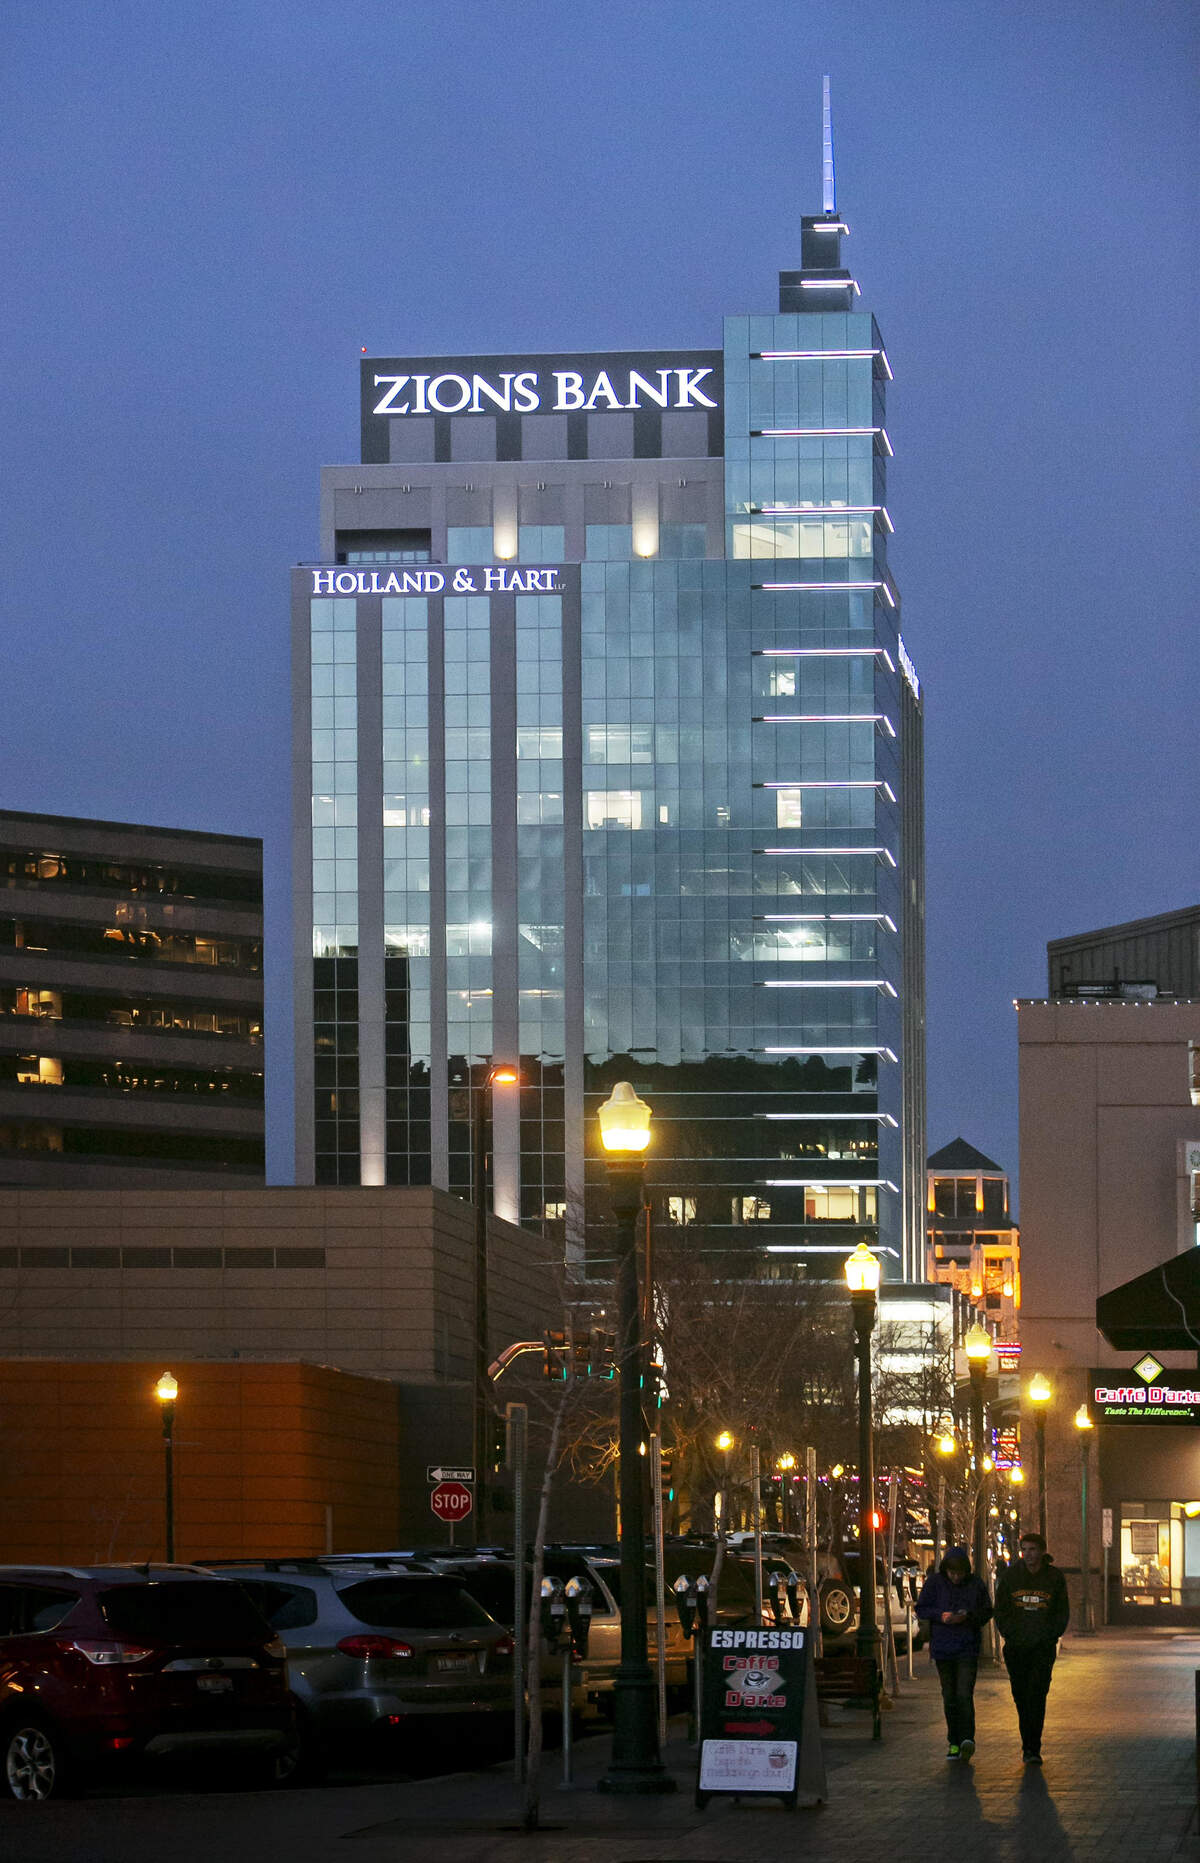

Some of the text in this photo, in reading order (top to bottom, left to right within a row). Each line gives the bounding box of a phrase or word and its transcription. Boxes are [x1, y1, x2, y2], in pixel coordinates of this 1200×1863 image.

[372, 367, 718, 415] ZIONS BANK
[312, 570, 445, 594] HOLLAND
[452, 568, 477, 592] &
[483, 568, 558, 591] HART
[1104, 1407, 1127, 1415] Taste
[1128, 1407, 1143, 1415] The
[434, 1494, 468, 1509] STOP
[711, 1630, 804, 1649] ESPRESSO
